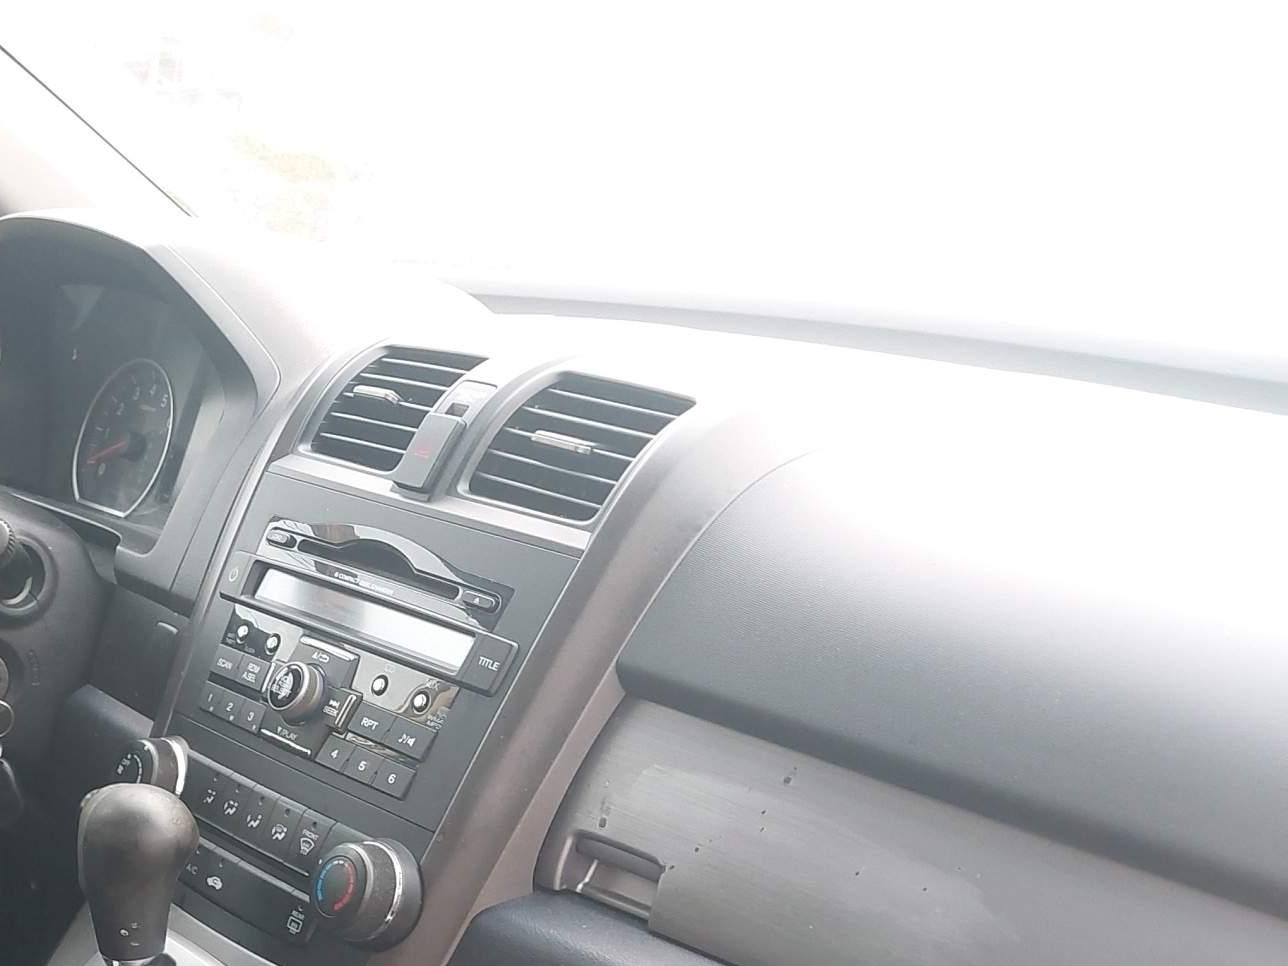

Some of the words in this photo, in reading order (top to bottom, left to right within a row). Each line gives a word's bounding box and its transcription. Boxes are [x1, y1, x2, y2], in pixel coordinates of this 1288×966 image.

[160, 394, 169, 408] 5
[478, 655, 501, 671] TITLE
[225, 702, 234, 711] 2
[247, 711, 255, 721] 3
[360, 716, 380, 731] RPT
[330, 749, 339, 759] 4
[357, 760, 368, 771] 5
[387, 773, 397, 784] 6
